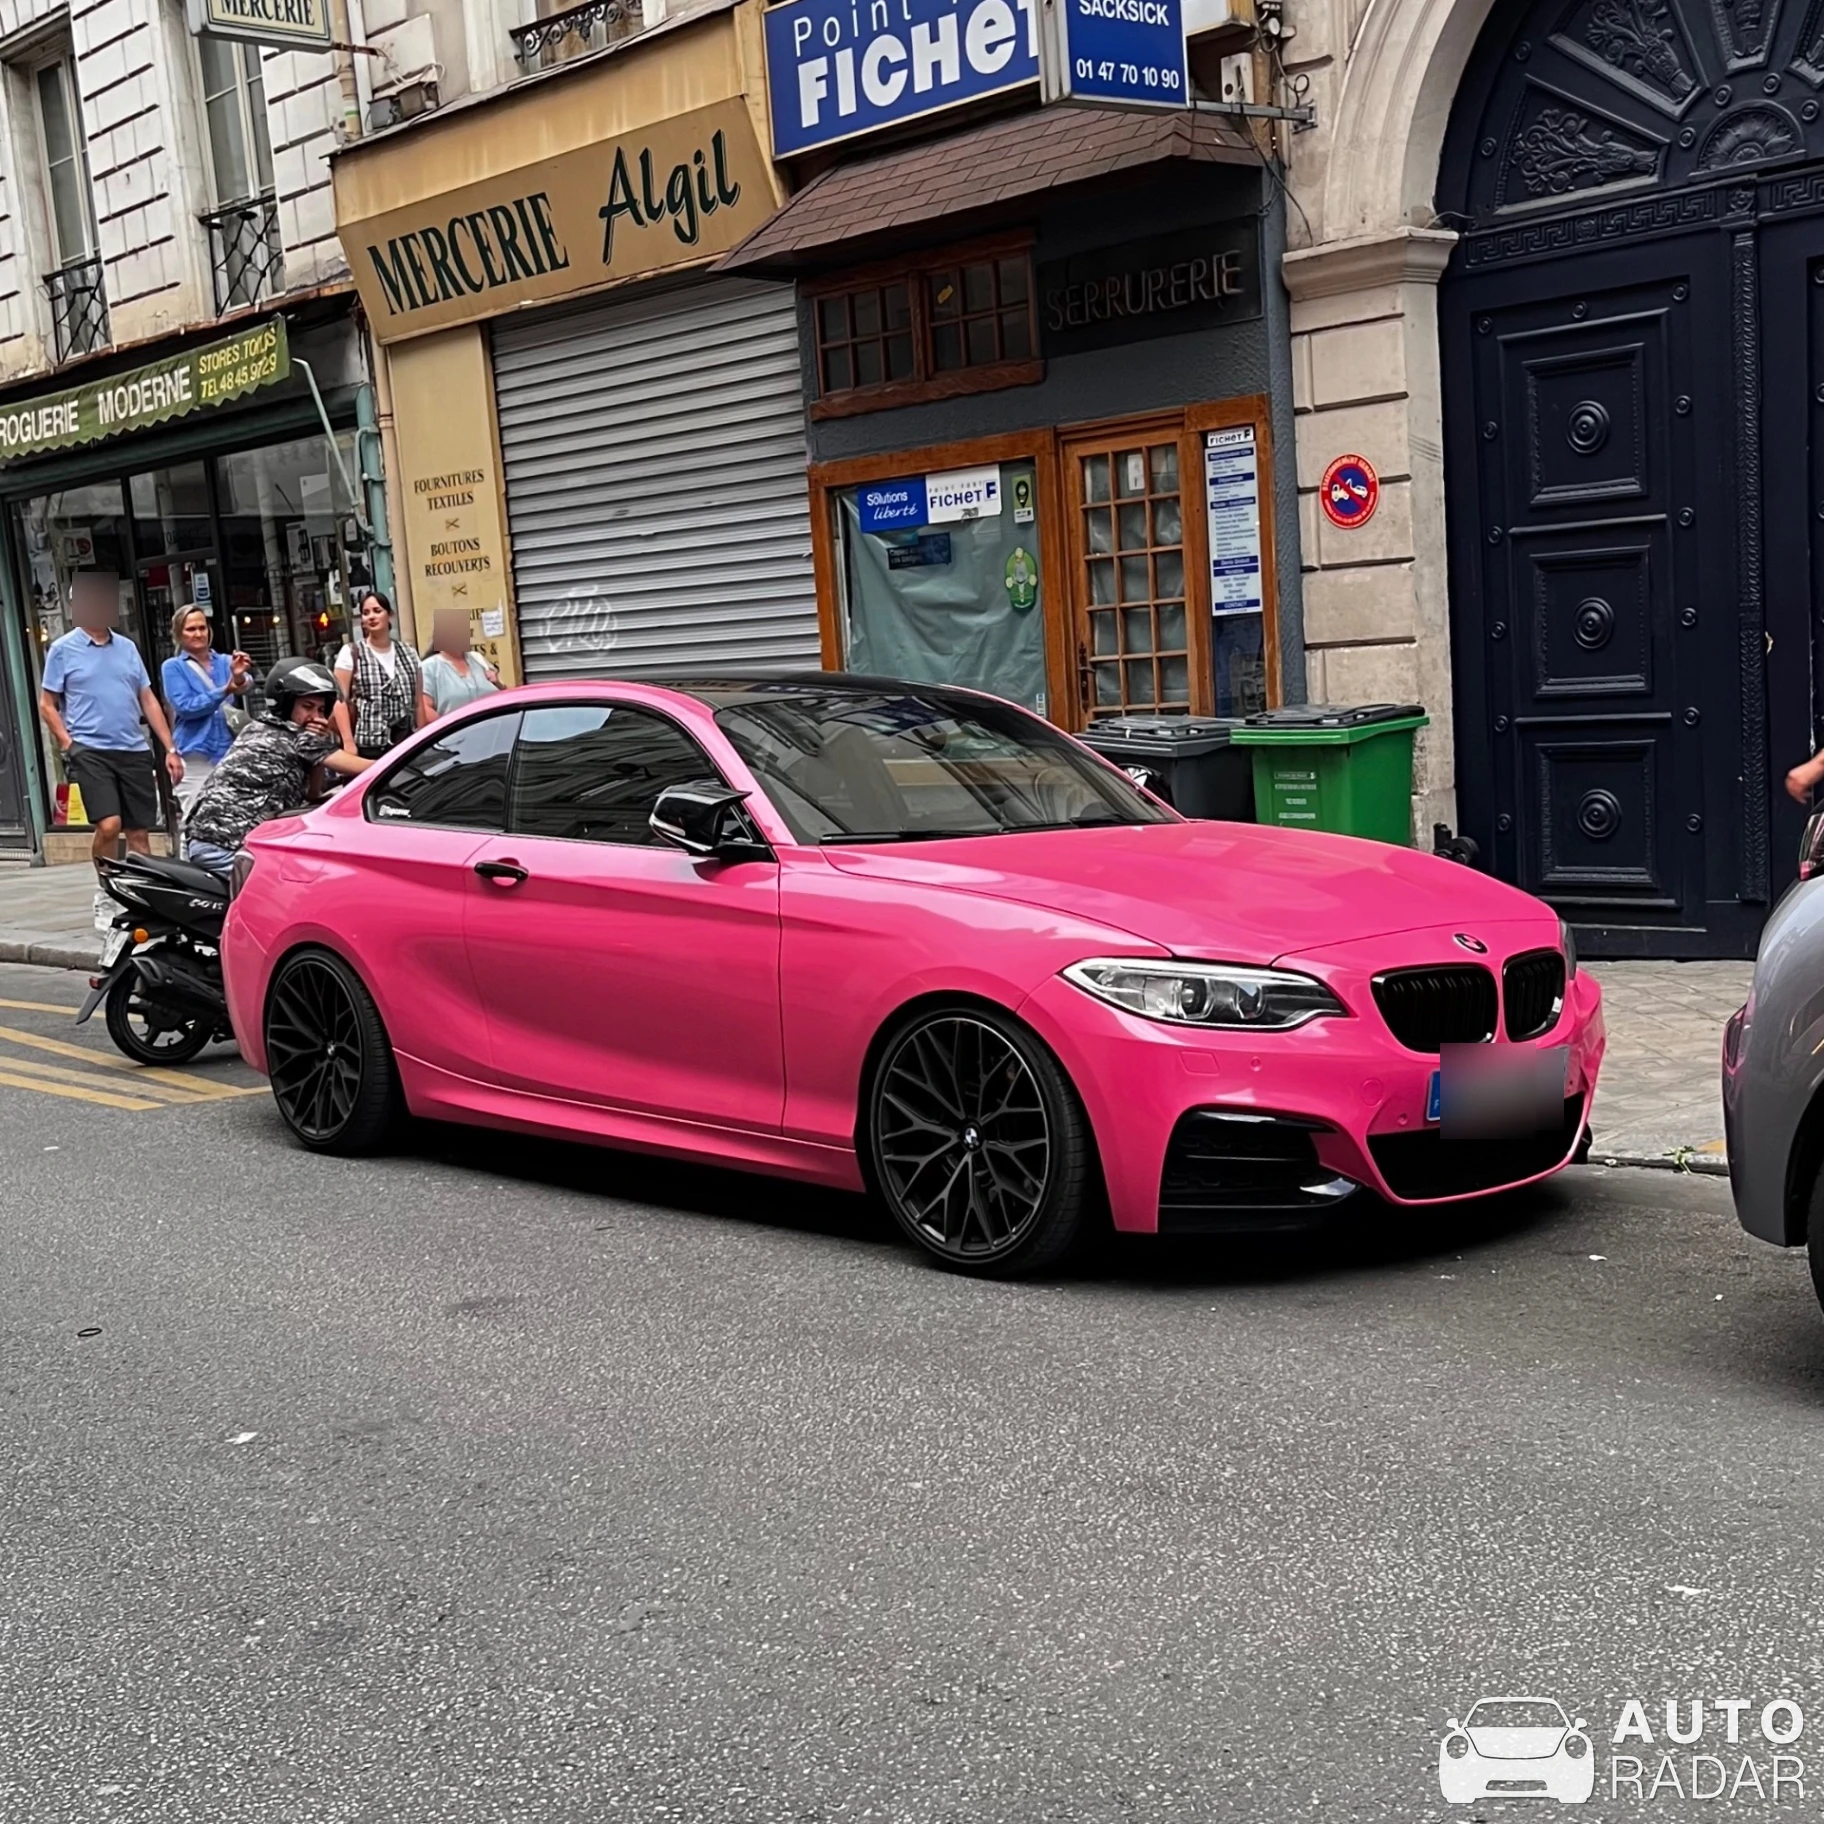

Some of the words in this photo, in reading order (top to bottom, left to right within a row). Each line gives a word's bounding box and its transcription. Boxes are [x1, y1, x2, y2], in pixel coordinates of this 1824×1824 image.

[1079, 0, 1170, 27] SACKSICK
[1076, 58, 1093, 79] 01
[1098, 61, 1115, 81] 47
[1120, 64, 1138, 84] 70
[1142, 66, 1158, 87] 10
[1161, 69, 1179, 89] 90
[366, 191, 570, 316] MERCERIE
[598, 129, 741, 265] Algil
[1046, 249, 1244, 331] SERRURERIE
[98, 365, 192, 425] MODERNE
[414, 469, 484, 494] FOURNITURES
[427, 491, 474, 511] TEXTILES
[874, 503, 918, 520] liberté
[430, 538, 480, 557] BOUTONS
[425, 556, 490, 577] RECOUVERTS
